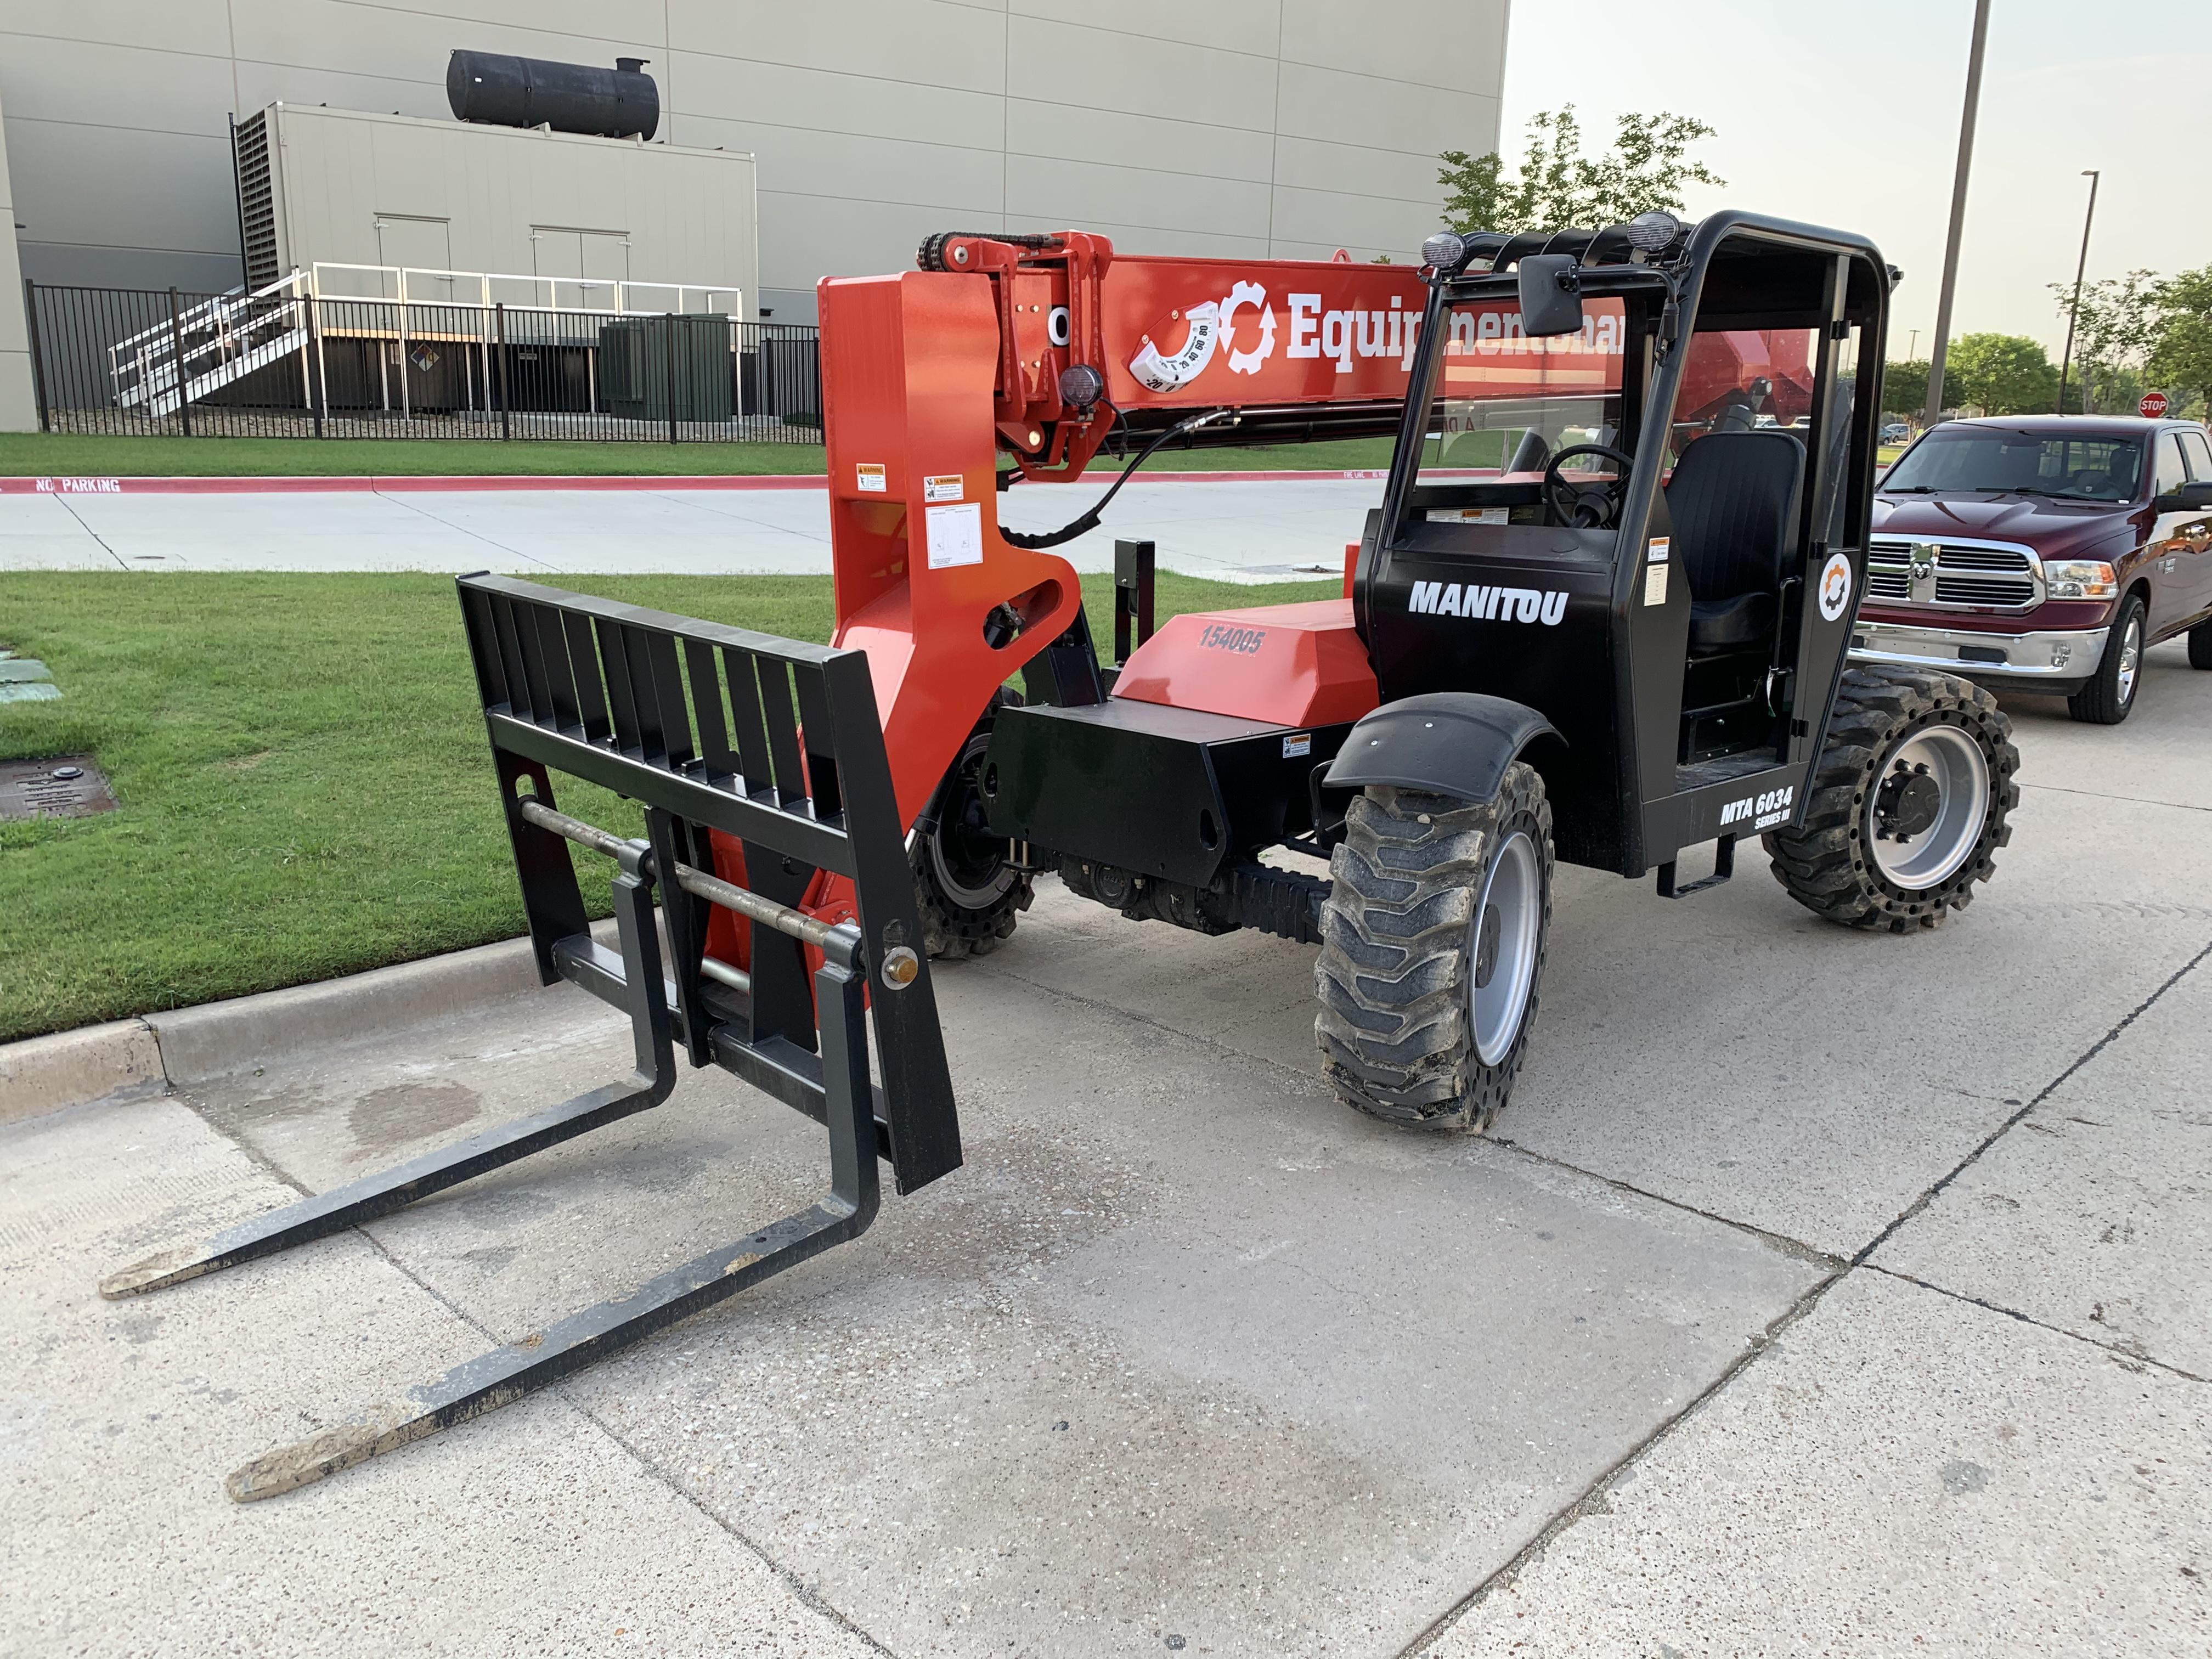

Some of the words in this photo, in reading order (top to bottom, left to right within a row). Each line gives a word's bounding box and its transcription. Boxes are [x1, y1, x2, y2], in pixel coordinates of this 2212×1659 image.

[1199, 325, 1208, 336] 80
[1195, 340, 1205, 350] 60
[1188, 352, 1199, 361] 40
[1179, 360, 1189, 369] 20
[2141, 400, 2166, 410] STOP
[36, 479, 54, 492] NO
[61, 479, 121, 492] PARKING
[1408, 580, 1570, 626] MANITOU
[1200, 625, 1266, 653] 154005
[1720, 797, 1753, 826] MTA
[1756, 786, 1793, 815] 6034
[1754, 811, 1781, 830] SERIES
[1781, 808, 1791, 822] III
